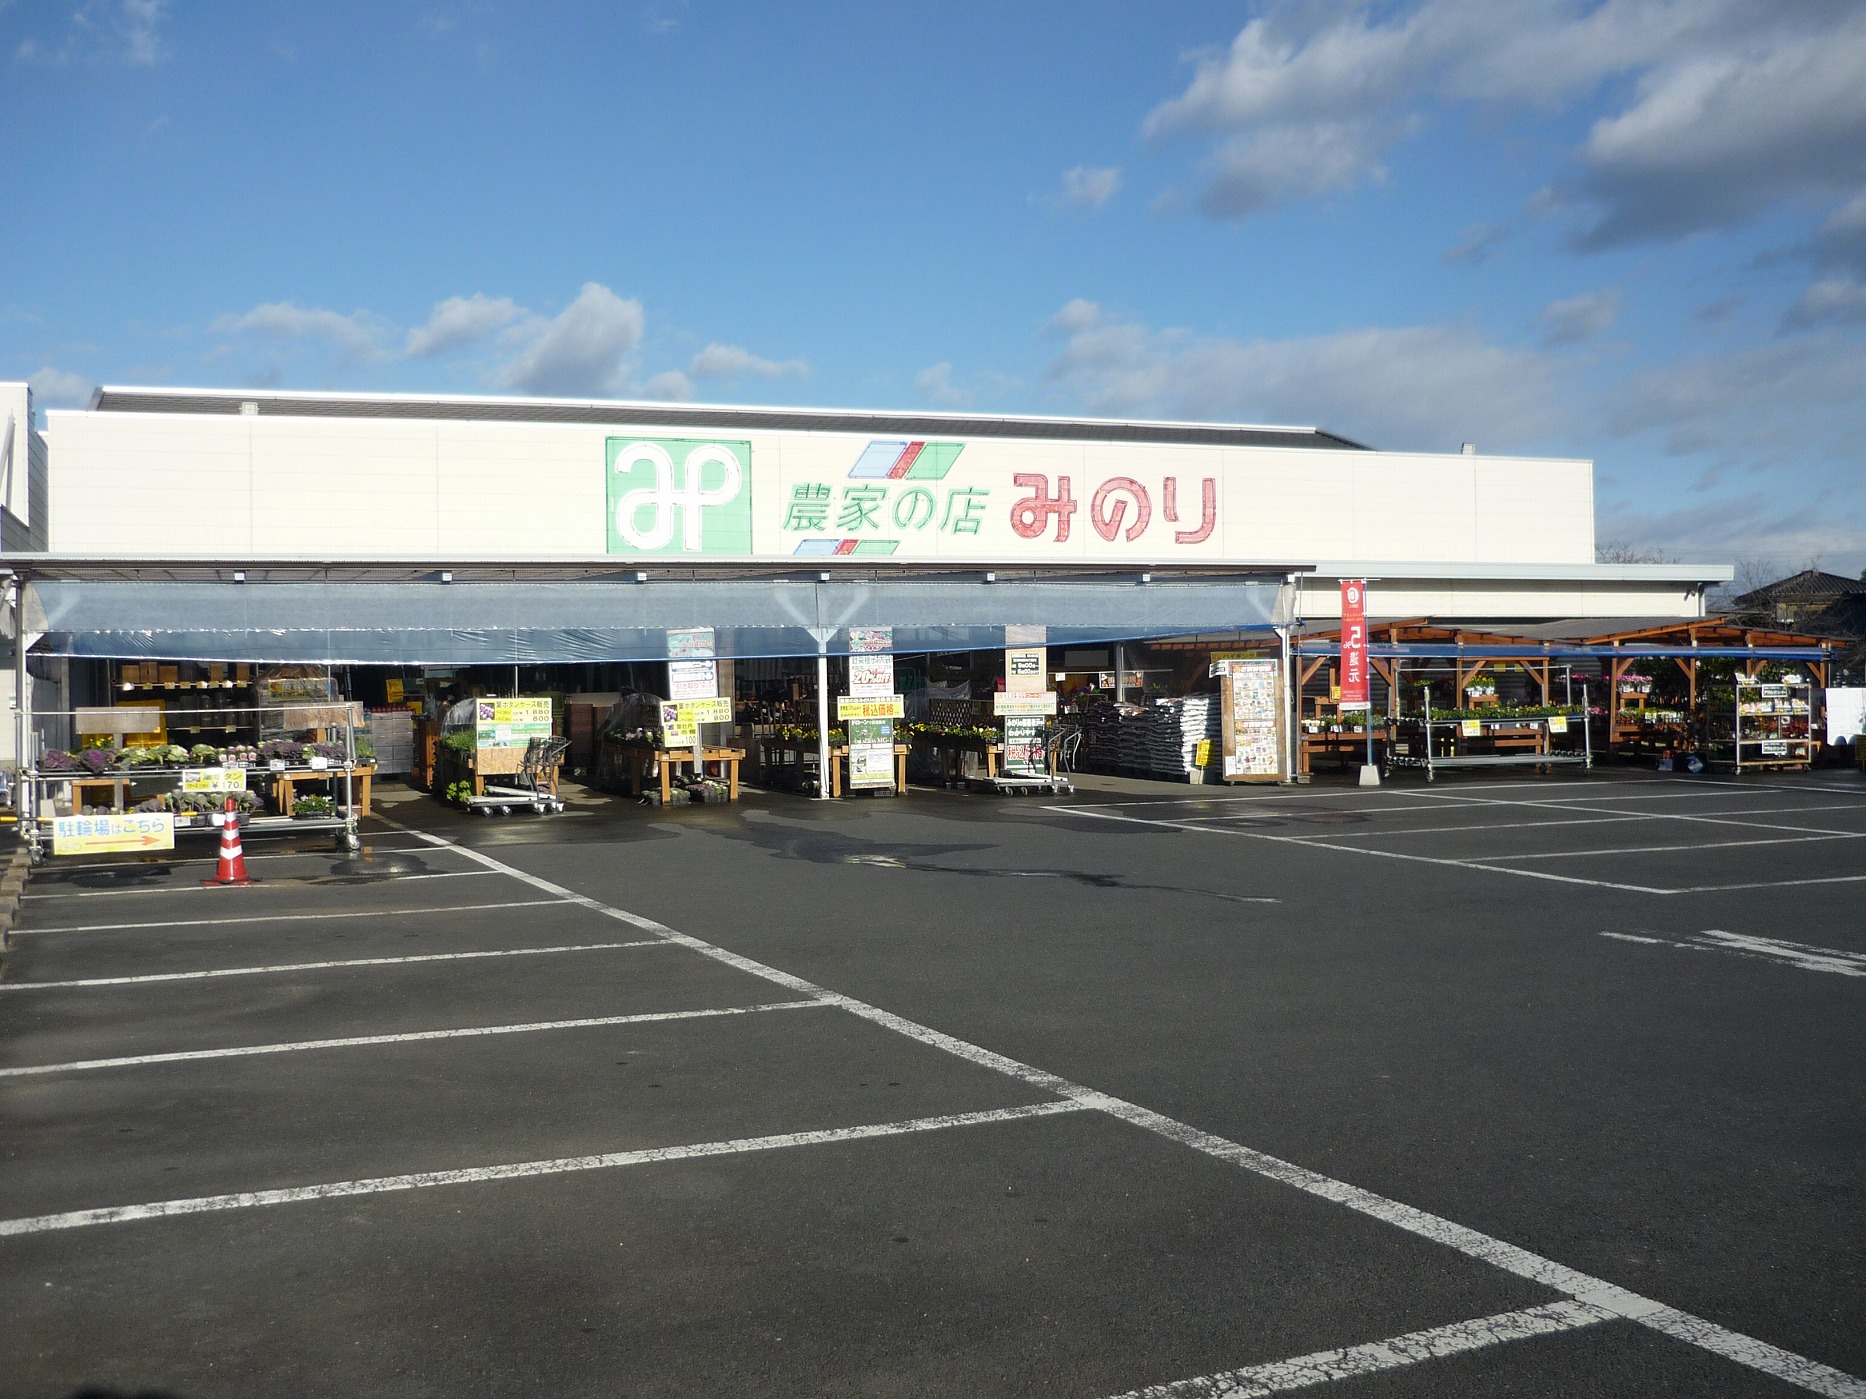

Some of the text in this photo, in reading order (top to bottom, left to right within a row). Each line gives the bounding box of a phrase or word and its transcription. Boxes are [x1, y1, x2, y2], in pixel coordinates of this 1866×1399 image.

[782, 472, 1216, 545] 農家の店 みのり
[862, 703, 894, 717] 税込価格
[59, 819, 165, 838] 駐輪場はこちら
